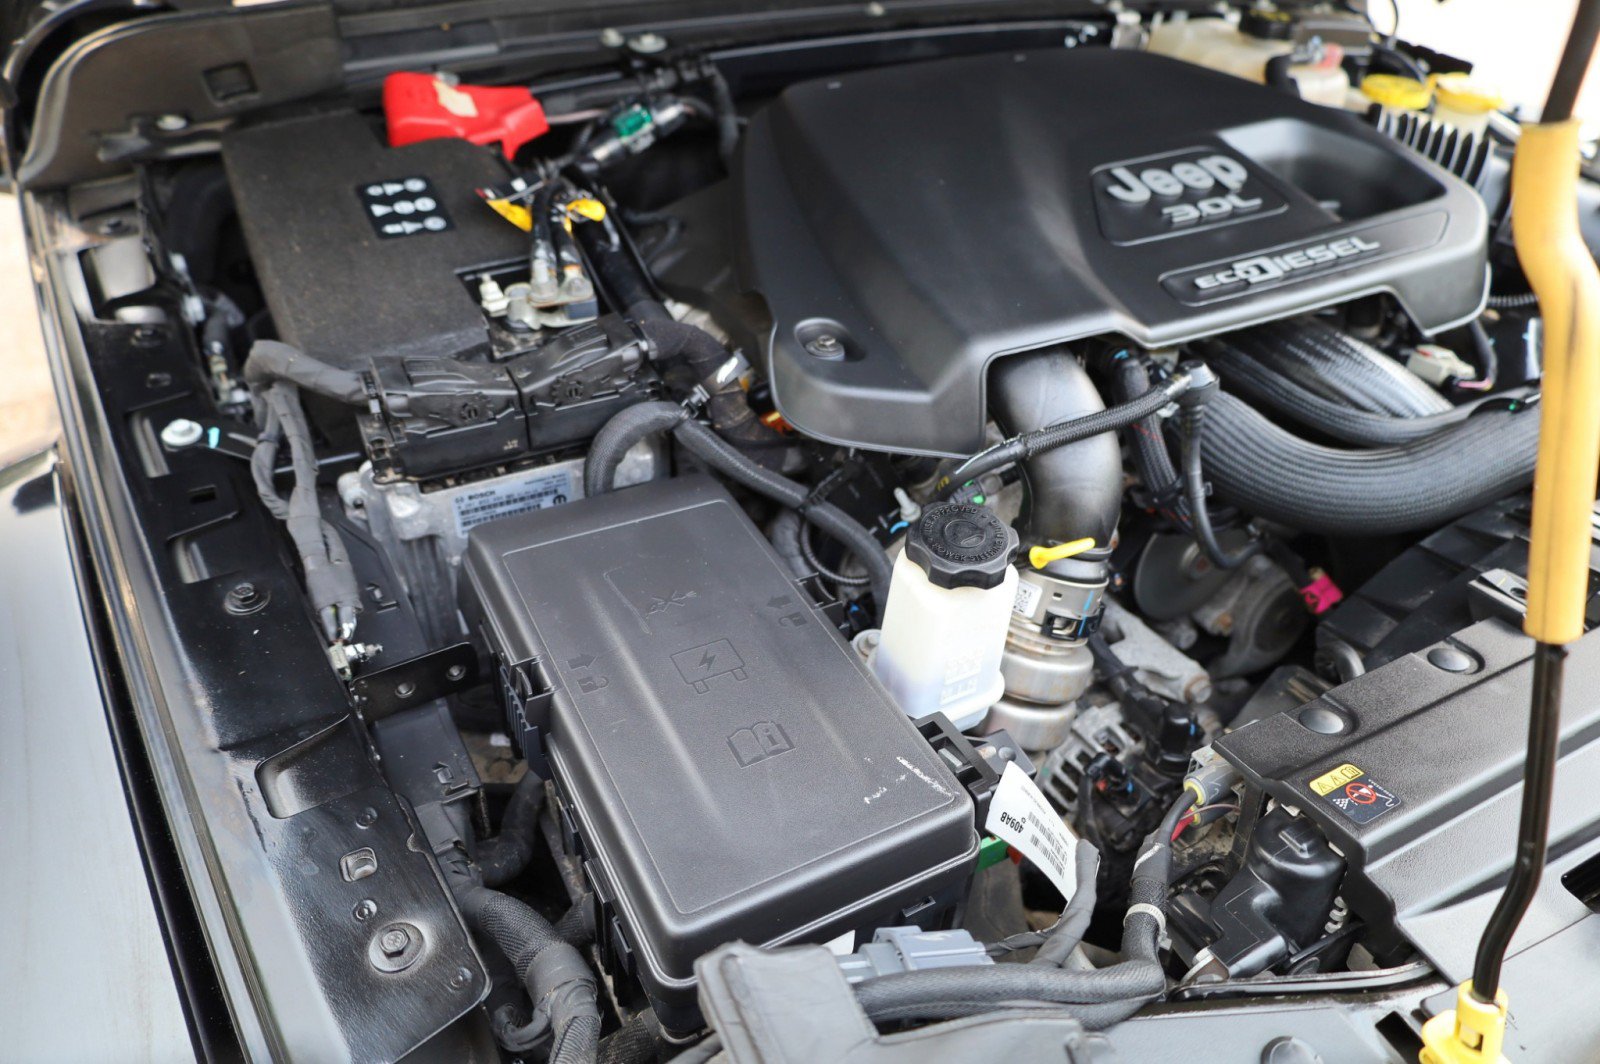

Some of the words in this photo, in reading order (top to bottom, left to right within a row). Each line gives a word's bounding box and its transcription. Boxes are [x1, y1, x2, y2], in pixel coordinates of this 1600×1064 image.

[1107, 155, 1248, 202] Jeep
[1195, 236, 1380, 289] ECODIESEL
[468, 490, 496, 500] BOSCH
[931, 504, 978, 520] APPROVED
[932, 542, 967, 561] POWER
[1000, 811, 1024, 834] 409AB
